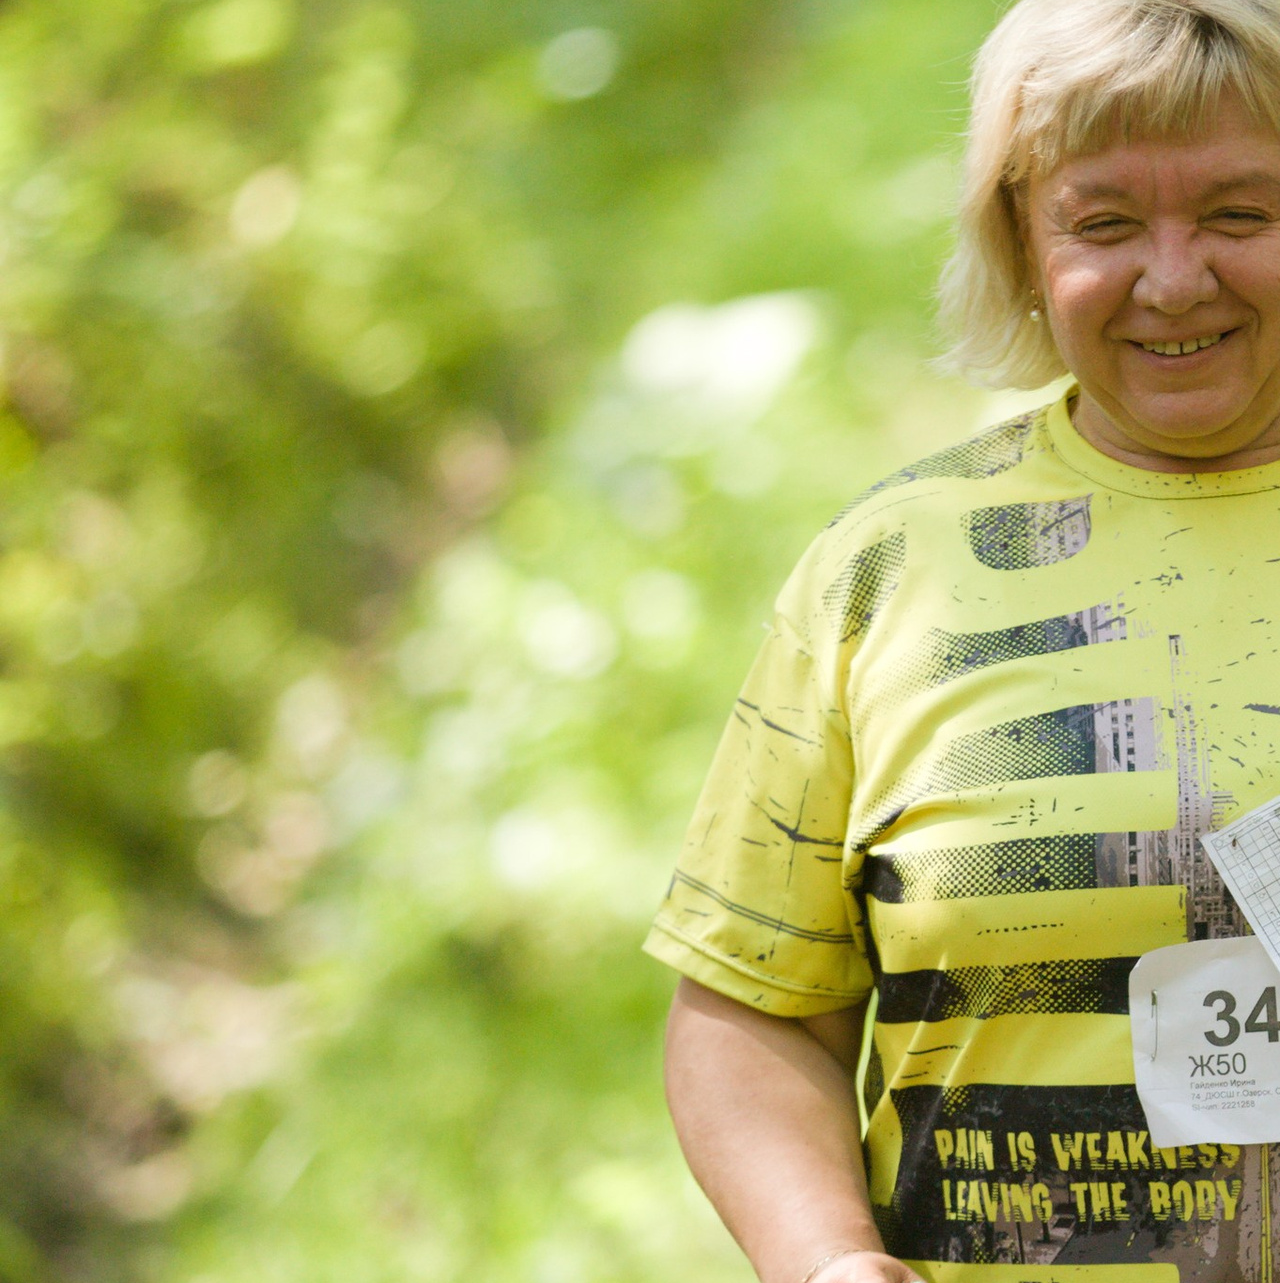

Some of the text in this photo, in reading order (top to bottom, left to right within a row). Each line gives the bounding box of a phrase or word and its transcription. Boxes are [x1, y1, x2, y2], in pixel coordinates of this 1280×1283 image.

[1188, 1052, 1247, 1077] Ж50
[1190, 1079, 1256, 1090] Гайденко Ирина
[934, 1128, 995, 1171] PAIN
[1007, 1131, 1037, 1172] IS
[942, 1179, 1242, 1223] LEAVING THE BODY
